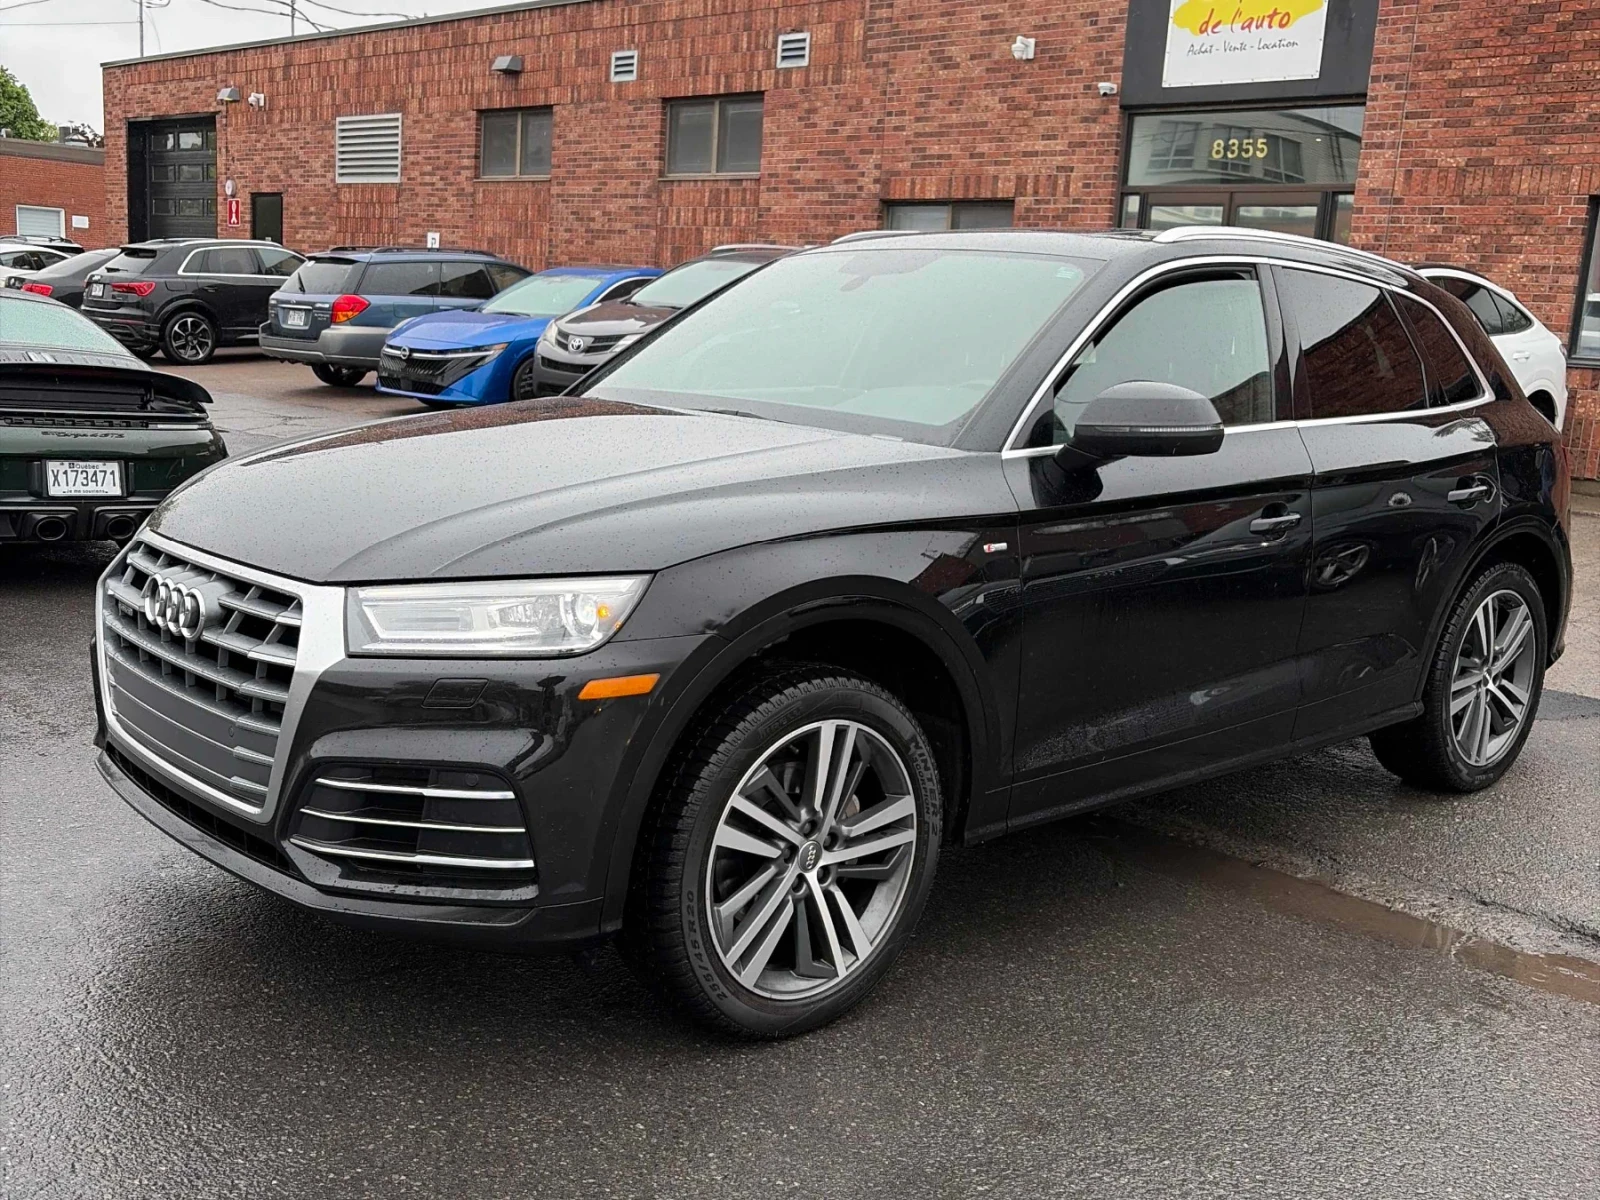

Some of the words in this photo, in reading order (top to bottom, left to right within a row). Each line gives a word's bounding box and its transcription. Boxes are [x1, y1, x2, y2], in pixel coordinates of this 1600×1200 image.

[1198, 8, 1222, 36] de
[1230, 7, 1291, 33] l'auto
[1186, 42, 1214, 57] Achat
[1223, 40, 1247, 53] Vente
[1257, 38, 1299, 51] Location
[1211, 138, 1268, 159] 8355
[51, 469, 116, 487] X173471
[912, 757, 931, 815] SCORPION
[686, 890, 697, 934] R20
[690, 939, 728, 1000] 255/45
